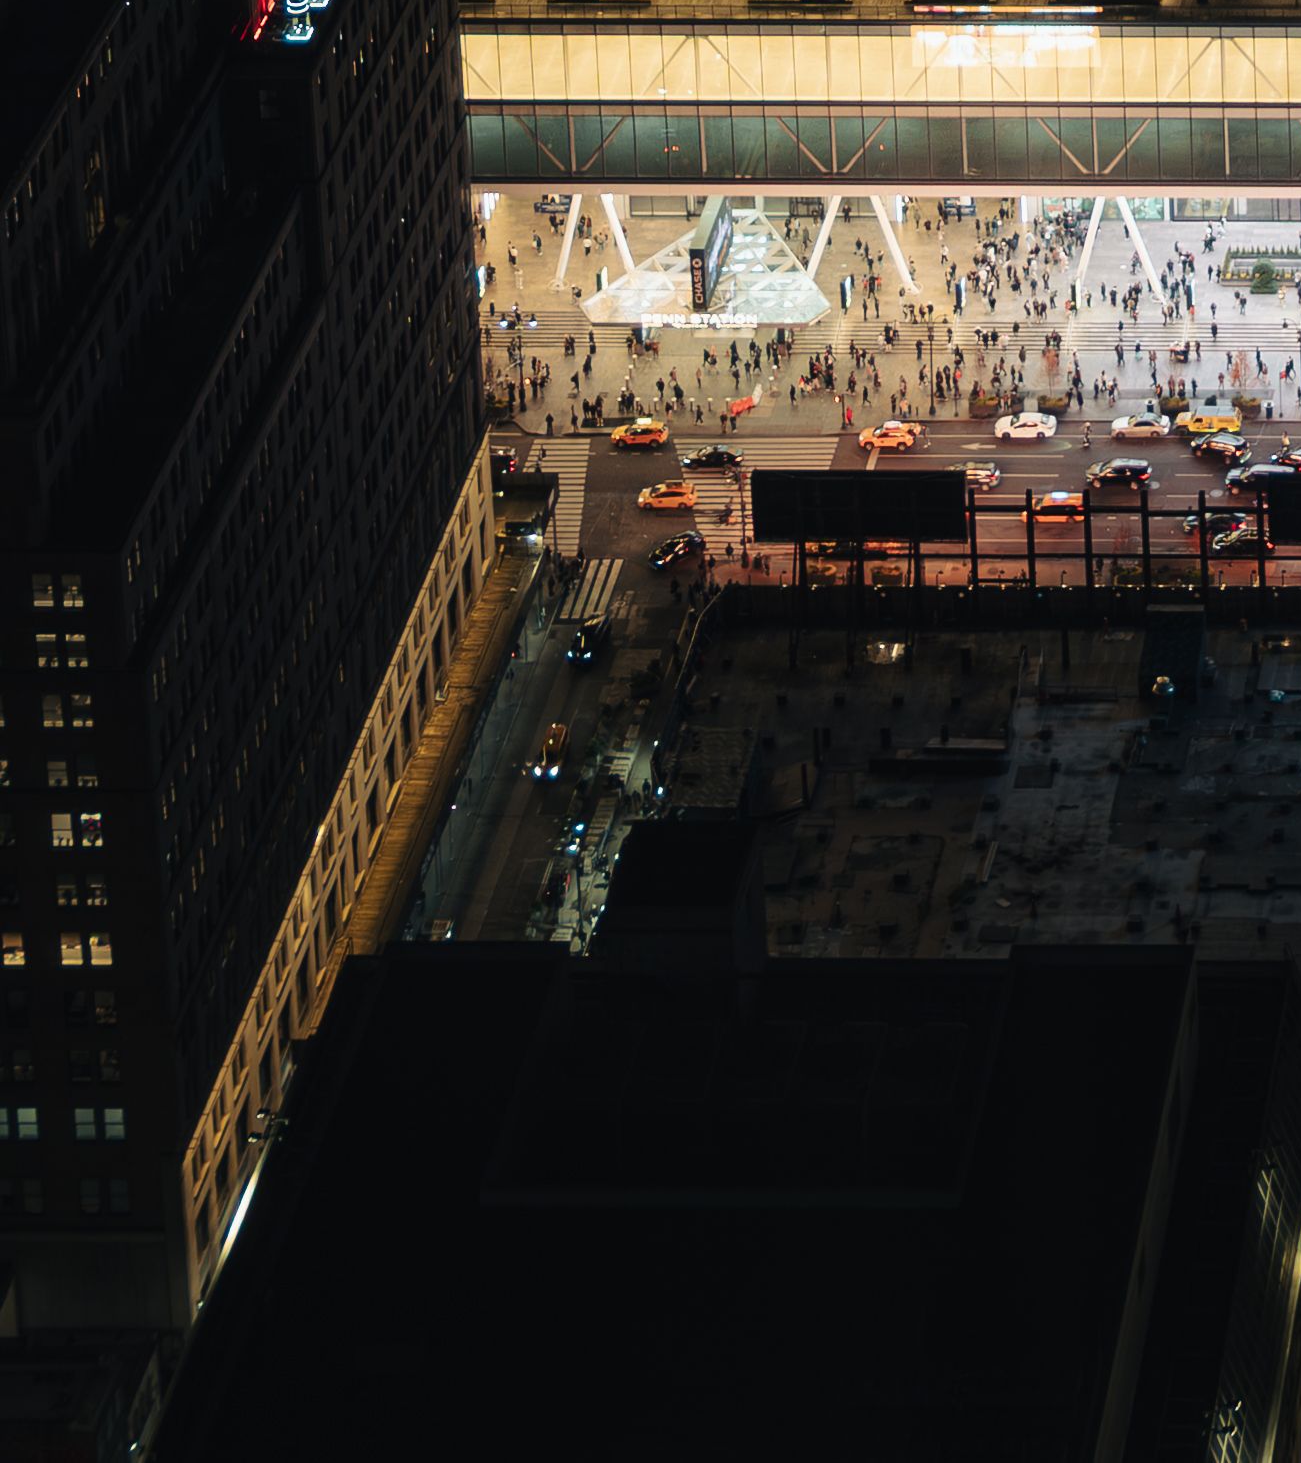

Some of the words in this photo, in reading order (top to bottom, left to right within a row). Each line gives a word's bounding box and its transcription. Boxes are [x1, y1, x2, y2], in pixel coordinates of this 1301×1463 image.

[694, 270, 704, 304] CHASE
[640, 313, 687, 325] PENN
[689, 313, 758, 325] STATION
